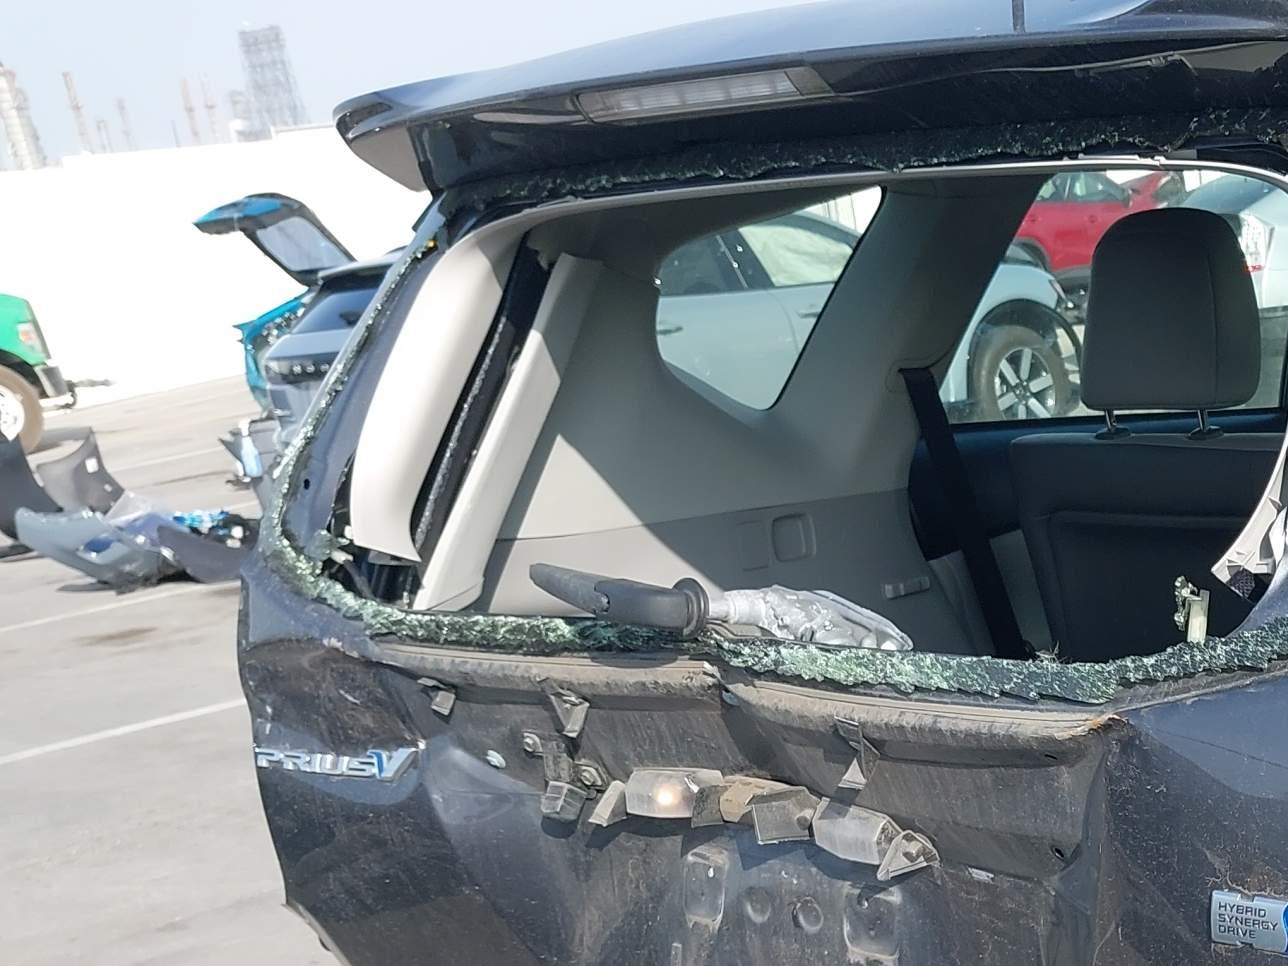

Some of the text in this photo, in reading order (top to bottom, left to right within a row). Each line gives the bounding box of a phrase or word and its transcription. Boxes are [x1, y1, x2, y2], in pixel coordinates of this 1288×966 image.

[254, 747, 376, 778] PRIUS
[1218, 901, 1267, 918] HYBRID
[1218, 913, 1279, 931] SYNERGY
[1218, 924, 1257, 939] DRIVE
